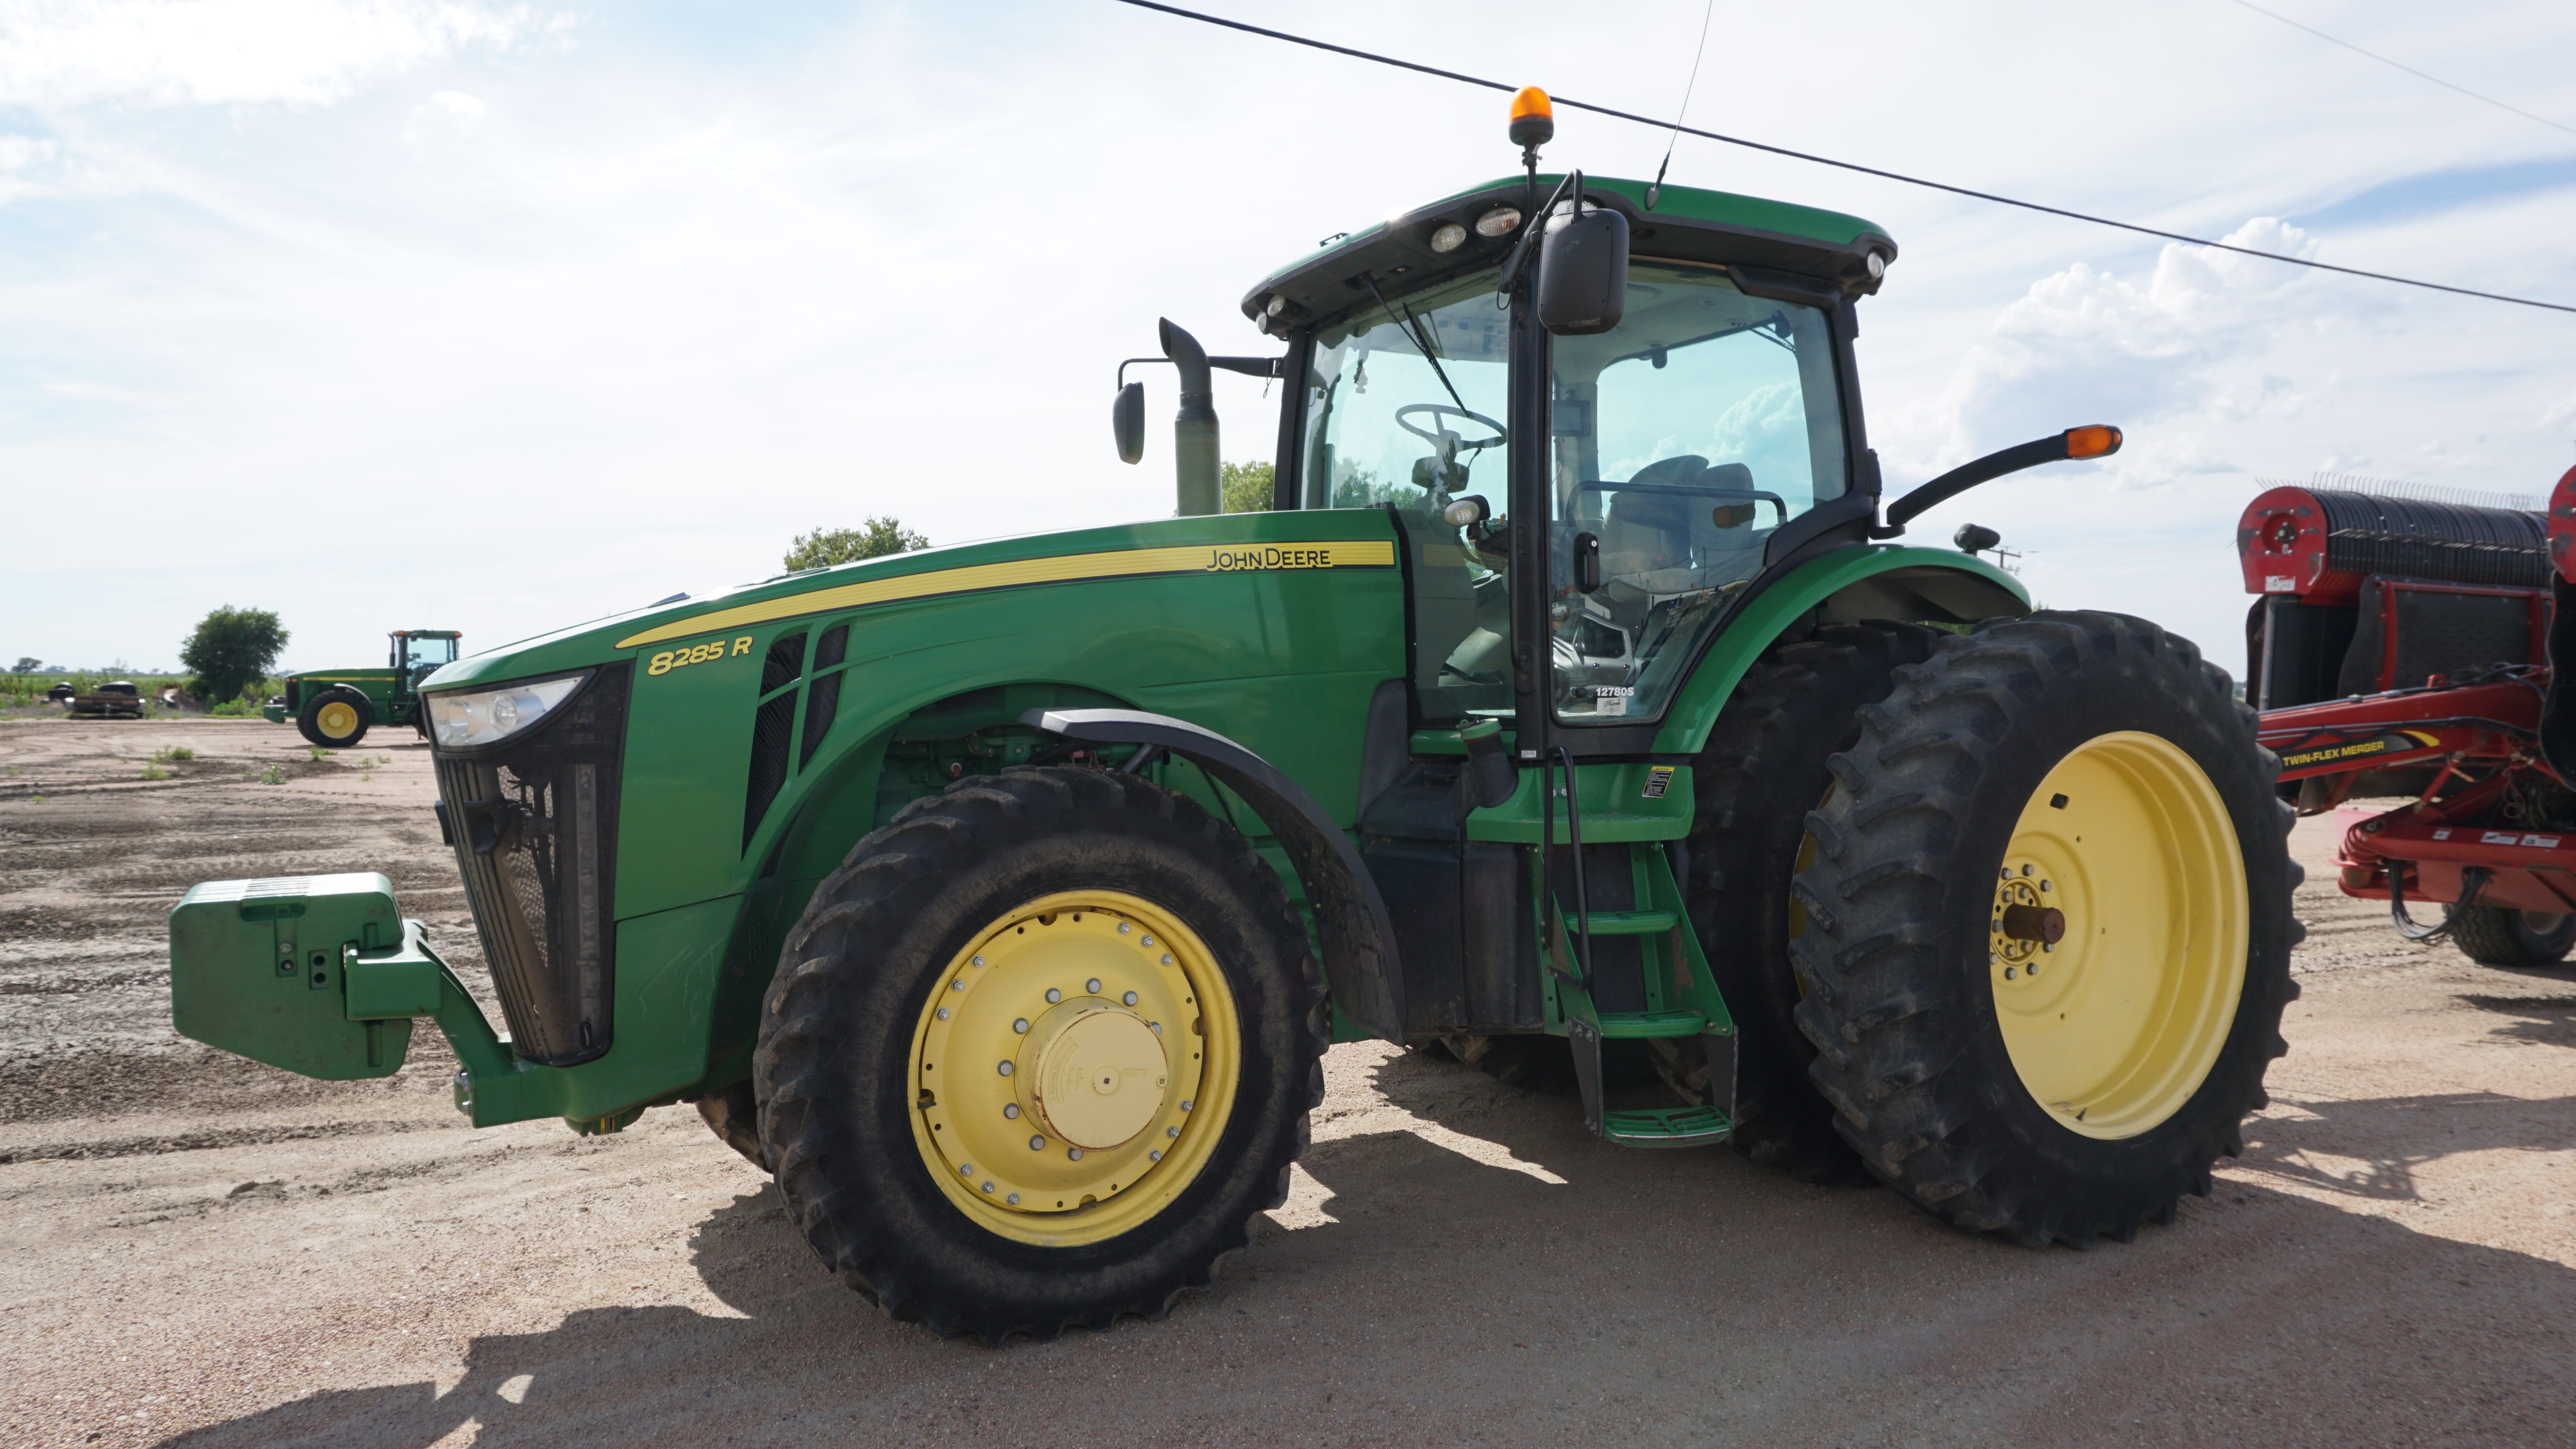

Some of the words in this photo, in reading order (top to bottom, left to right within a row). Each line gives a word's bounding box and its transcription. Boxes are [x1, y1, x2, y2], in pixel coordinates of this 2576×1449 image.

[1206, 549, 1262, 569] JOHN
[1265, 548, 1331, 566] DEERE
[647, 640, 727, 676] 8285
[731, 636, 753, 658] R
[1596, 687, 1634, 696] 12780S
[2282, 748, 2339, 767] TWIN-FLEX
[2341, 741, 2385, 757] MERGER
